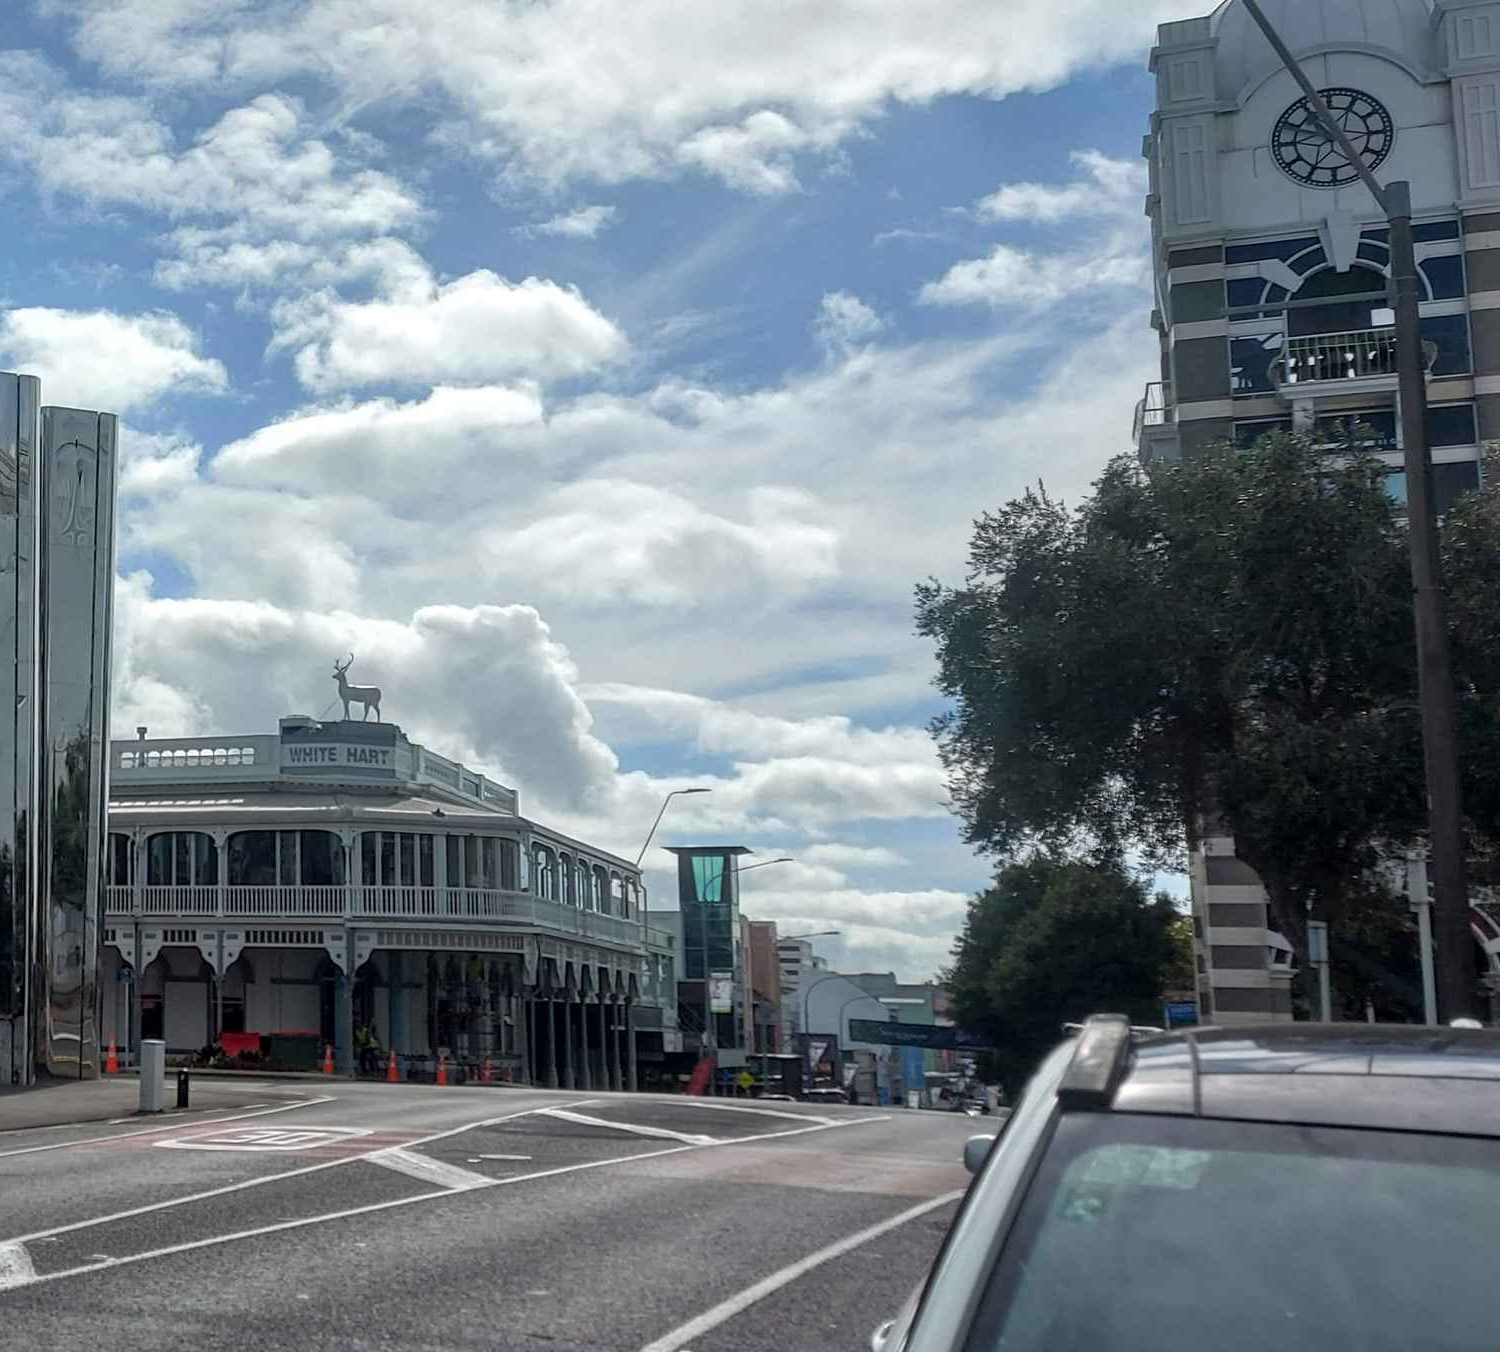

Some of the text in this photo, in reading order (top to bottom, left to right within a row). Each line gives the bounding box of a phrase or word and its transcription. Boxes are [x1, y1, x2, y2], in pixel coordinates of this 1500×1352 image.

[290, 747, 389, 765] WHITE HART
[206, 1131, 329, 1145] 30
